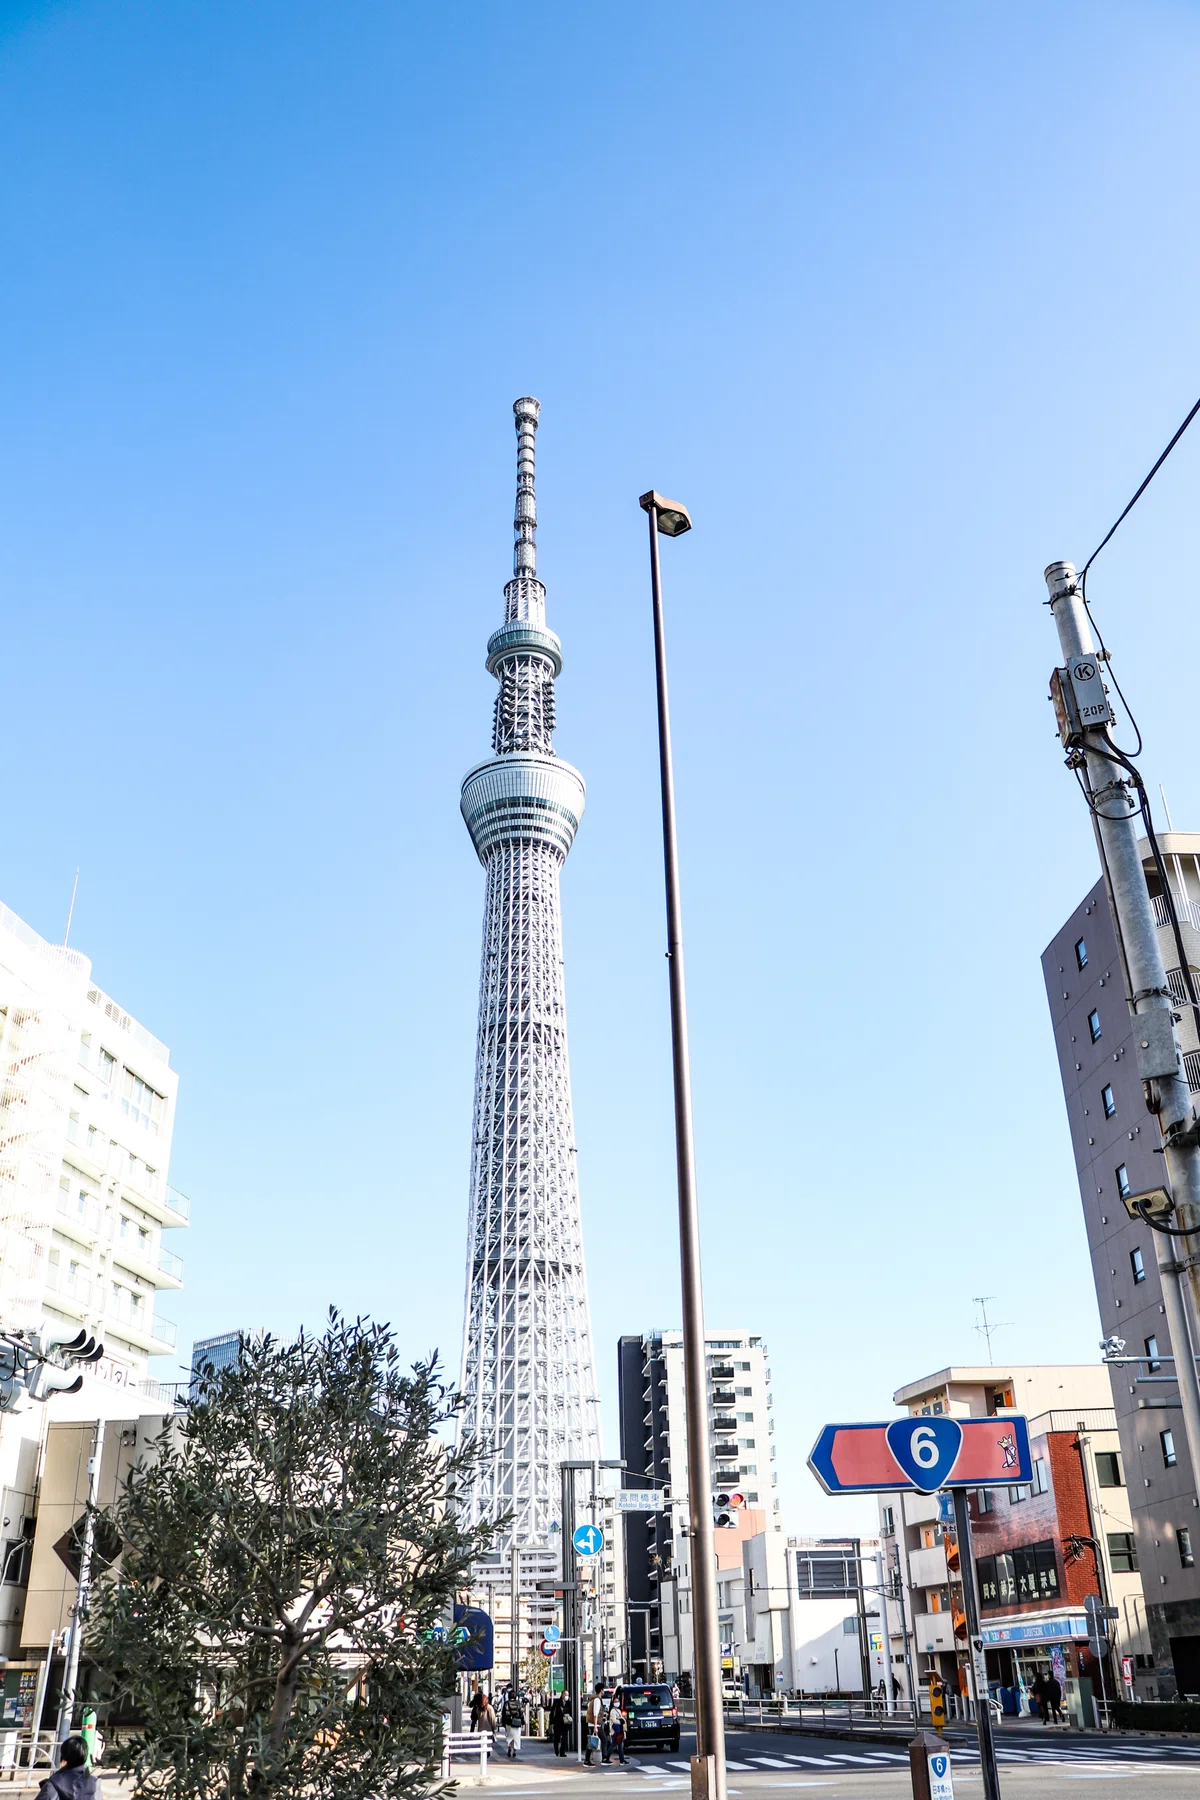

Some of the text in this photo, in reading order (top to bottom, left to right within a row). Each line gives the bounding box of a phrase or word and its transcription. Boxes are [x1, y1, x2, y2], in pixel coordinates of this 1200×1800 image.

[1083, 704, 1105, 717] 20P
[910, 1426, 940, 1469] 6
[619, 1492, 660, 1502] 言問橋東
[936, 1757, 943, 1773] 6
